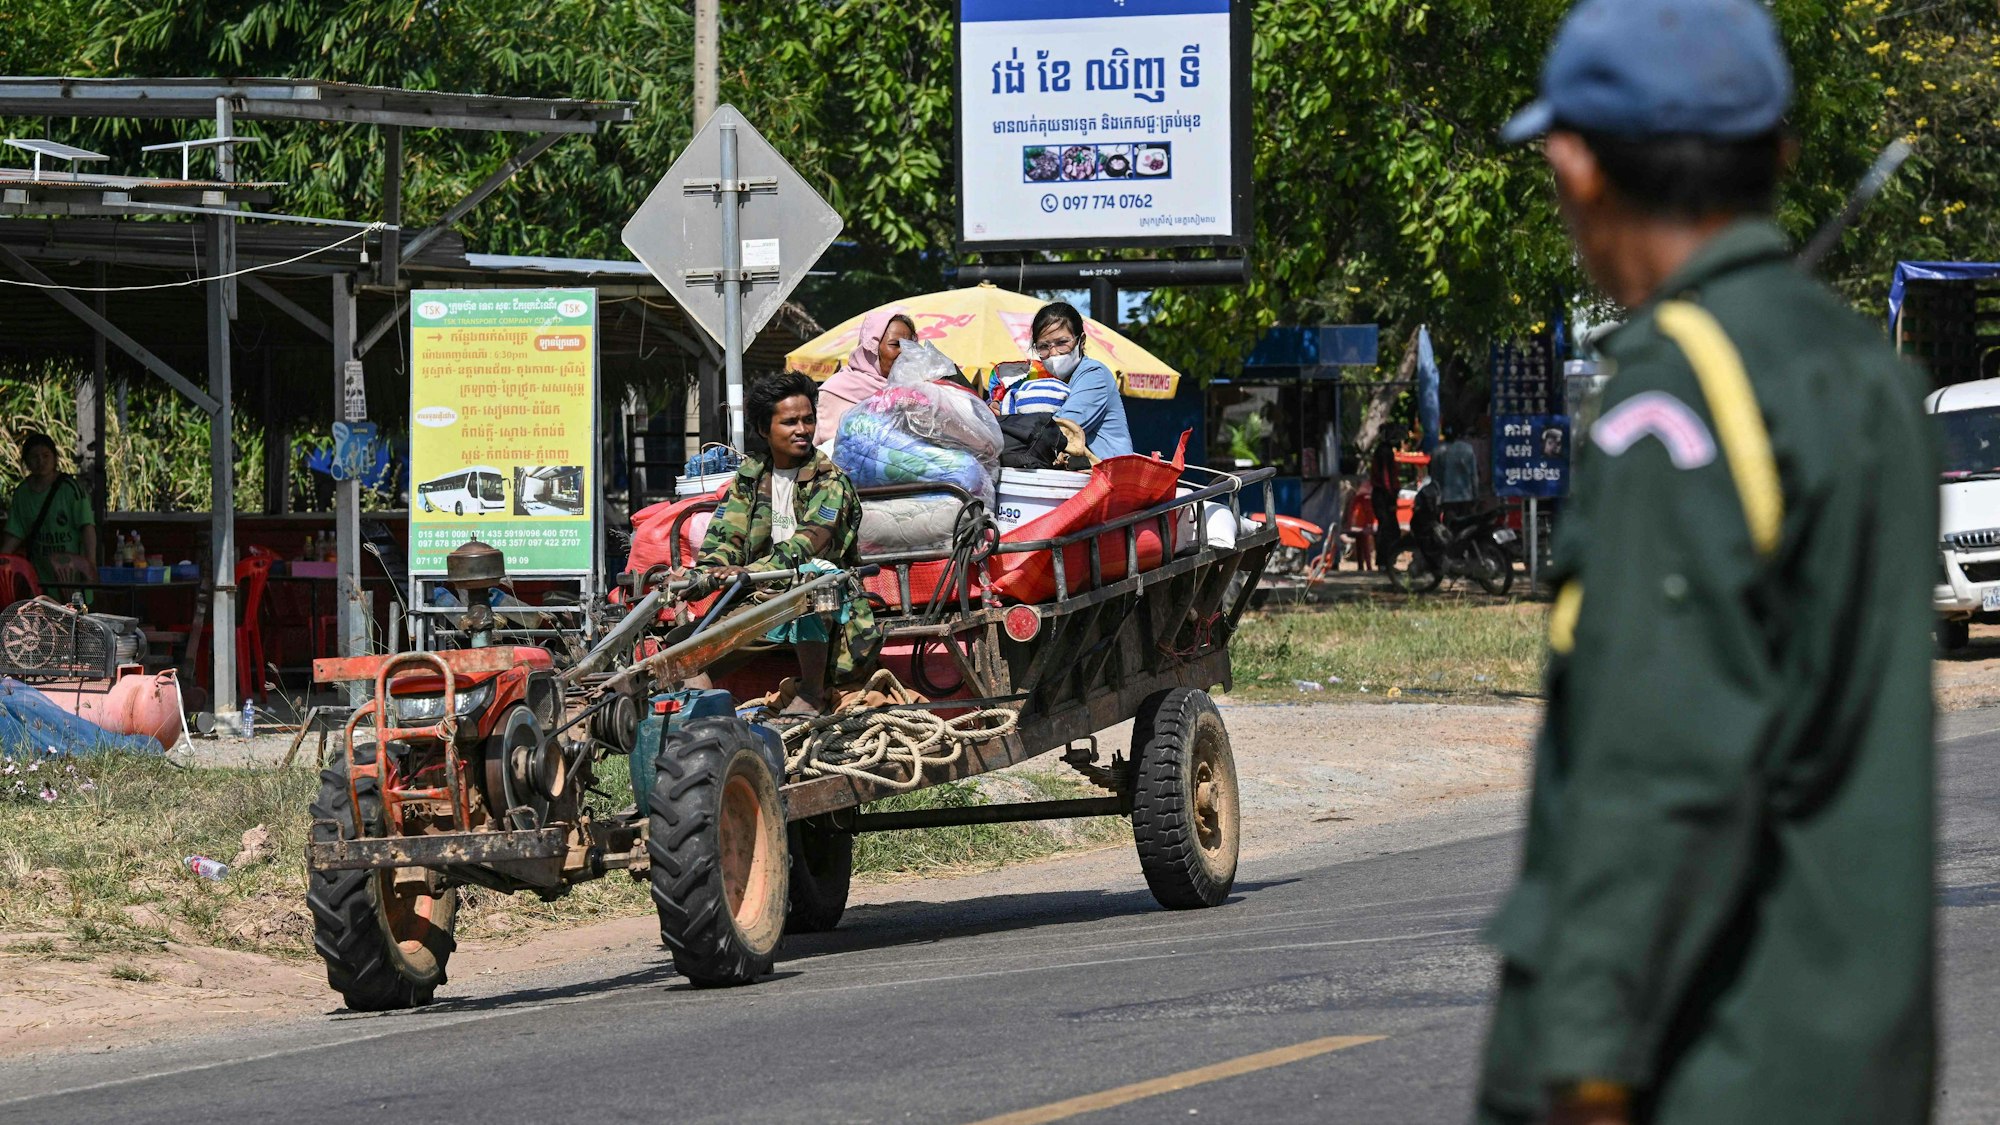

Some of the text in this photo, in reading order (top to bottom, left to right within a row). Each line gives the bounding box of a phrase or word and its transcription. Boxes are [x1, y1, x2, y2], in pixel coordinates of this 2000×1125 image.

[1036, 50, 1071, 93] ខែ
[1180, 43, 1200, 88] ទី
[1063, 194, 1153, 211] 097 774 0762
[424, 305, 441, 315] TSK
[564, 303, 581, 313] TSK
[498, 317, 534, 325] COMPANY
[494, 350, 528, 361] 6:30pm
[418, 530, 433, 538] 015
[435, 530, 449, 538] 481
[487, 529, 503, 538] 435
[542, 529, 557, 537] 400
[559, 529, 578, 537] 5751
[417, 539, 433, 548] 097
[434, 539, 450, 548] 678
[527, 538, 543, 547] 097
[544, 538, 560, 547] 422
[561, 538, 581, 547] 2707
[416, 556, 529, 565] 071 97 99 09
